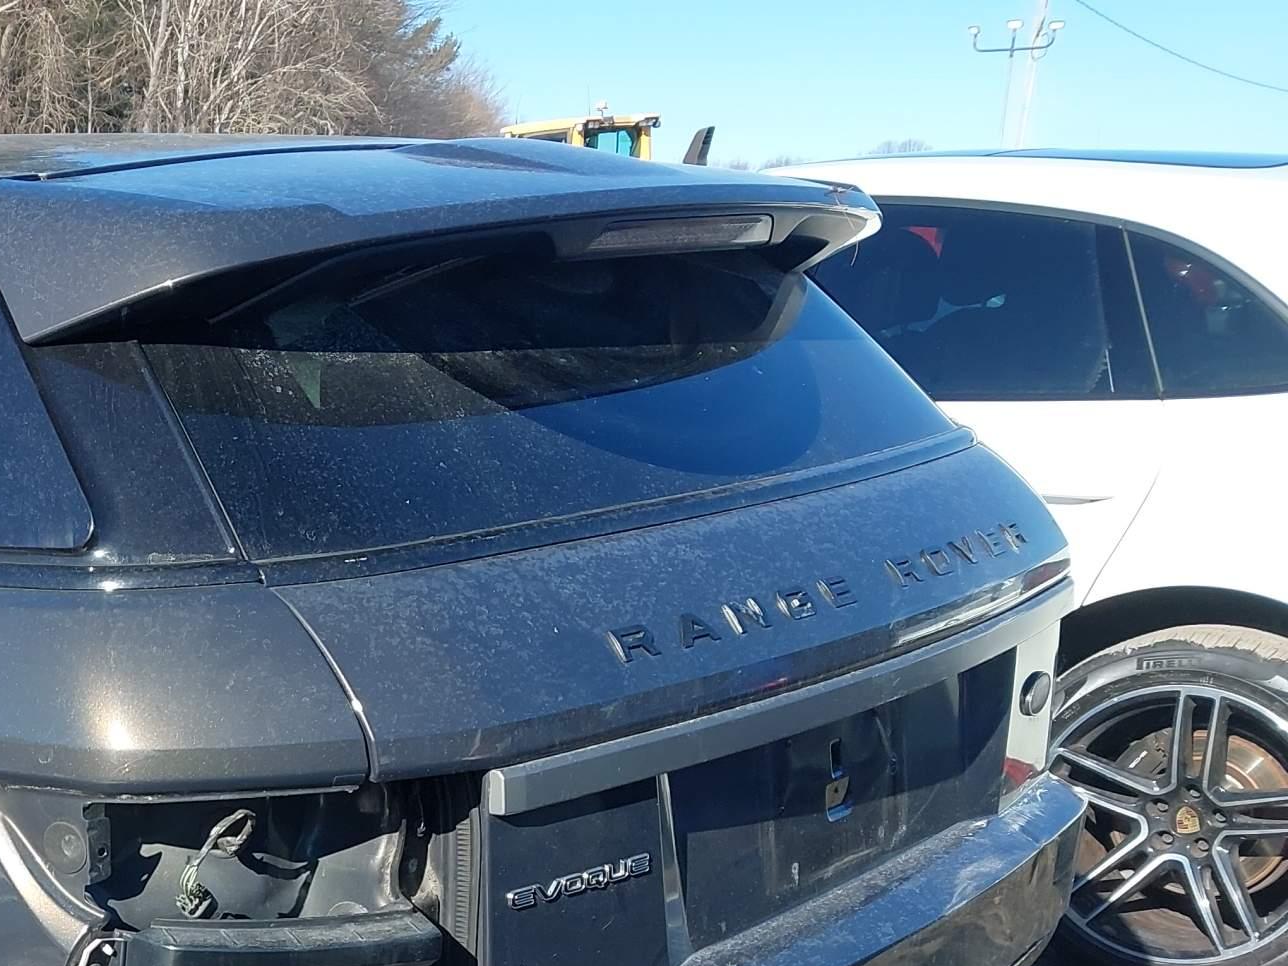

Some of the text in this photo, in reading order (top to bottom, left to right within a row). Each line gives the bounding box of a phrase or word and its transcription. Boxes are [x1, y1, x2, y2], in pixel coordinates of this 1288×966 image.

[607, 522, 1029, 666] RANGE ROVER
[507, 853, 651, 909] EVOQUE
